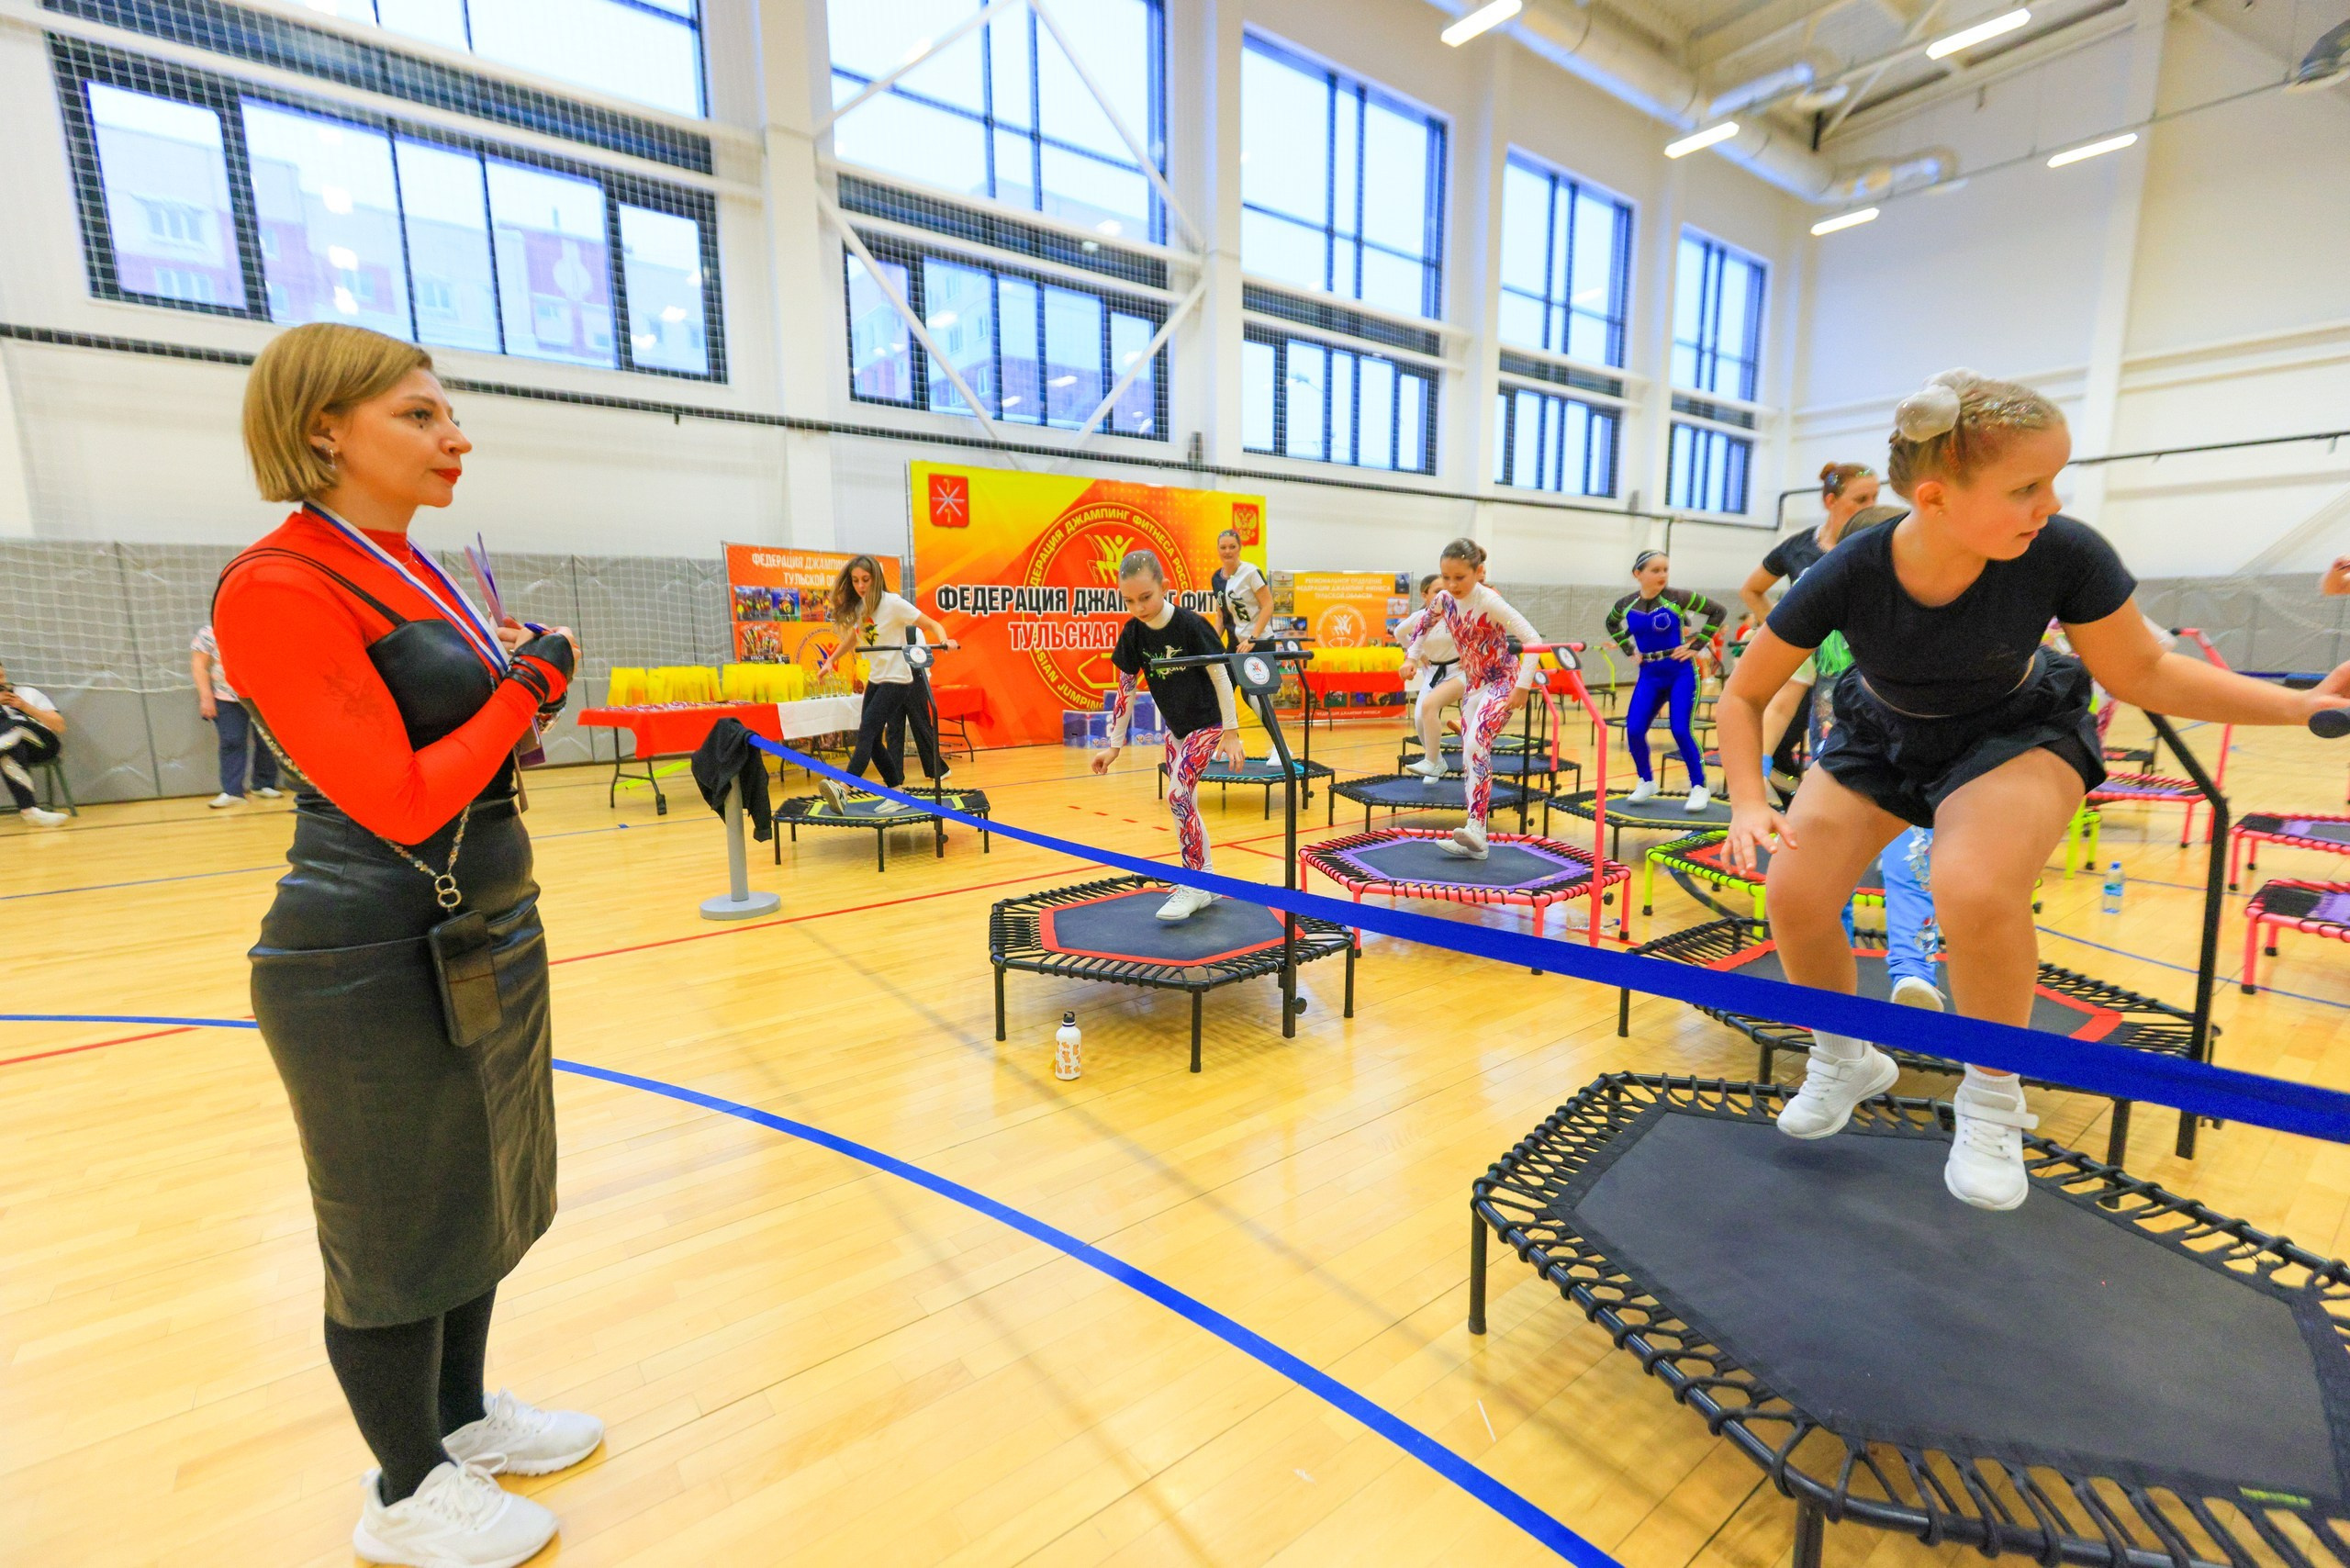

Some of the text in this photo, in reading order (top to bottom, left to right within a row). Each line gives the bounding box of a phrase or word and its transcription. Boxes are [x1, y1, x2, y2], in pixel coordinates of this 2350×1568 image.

[752, 553, 849, 570] ФЕДЕРАЦИЯ ДЖАМПИН
[1029, 508, 1189, 590] ДЕРАЦИЯ ДЖАМПИНГ ФИТНЕСА РОСС
[784, 572, 824, 586] ТУЛЬСКОЙ
[936, 585, 1068, 617] ФЕДЕРАЦИЯ
[1008, 621, 1118, 650] ТУЛЬСКАЯ
[1035, 647, 1059, 682] SIAN
